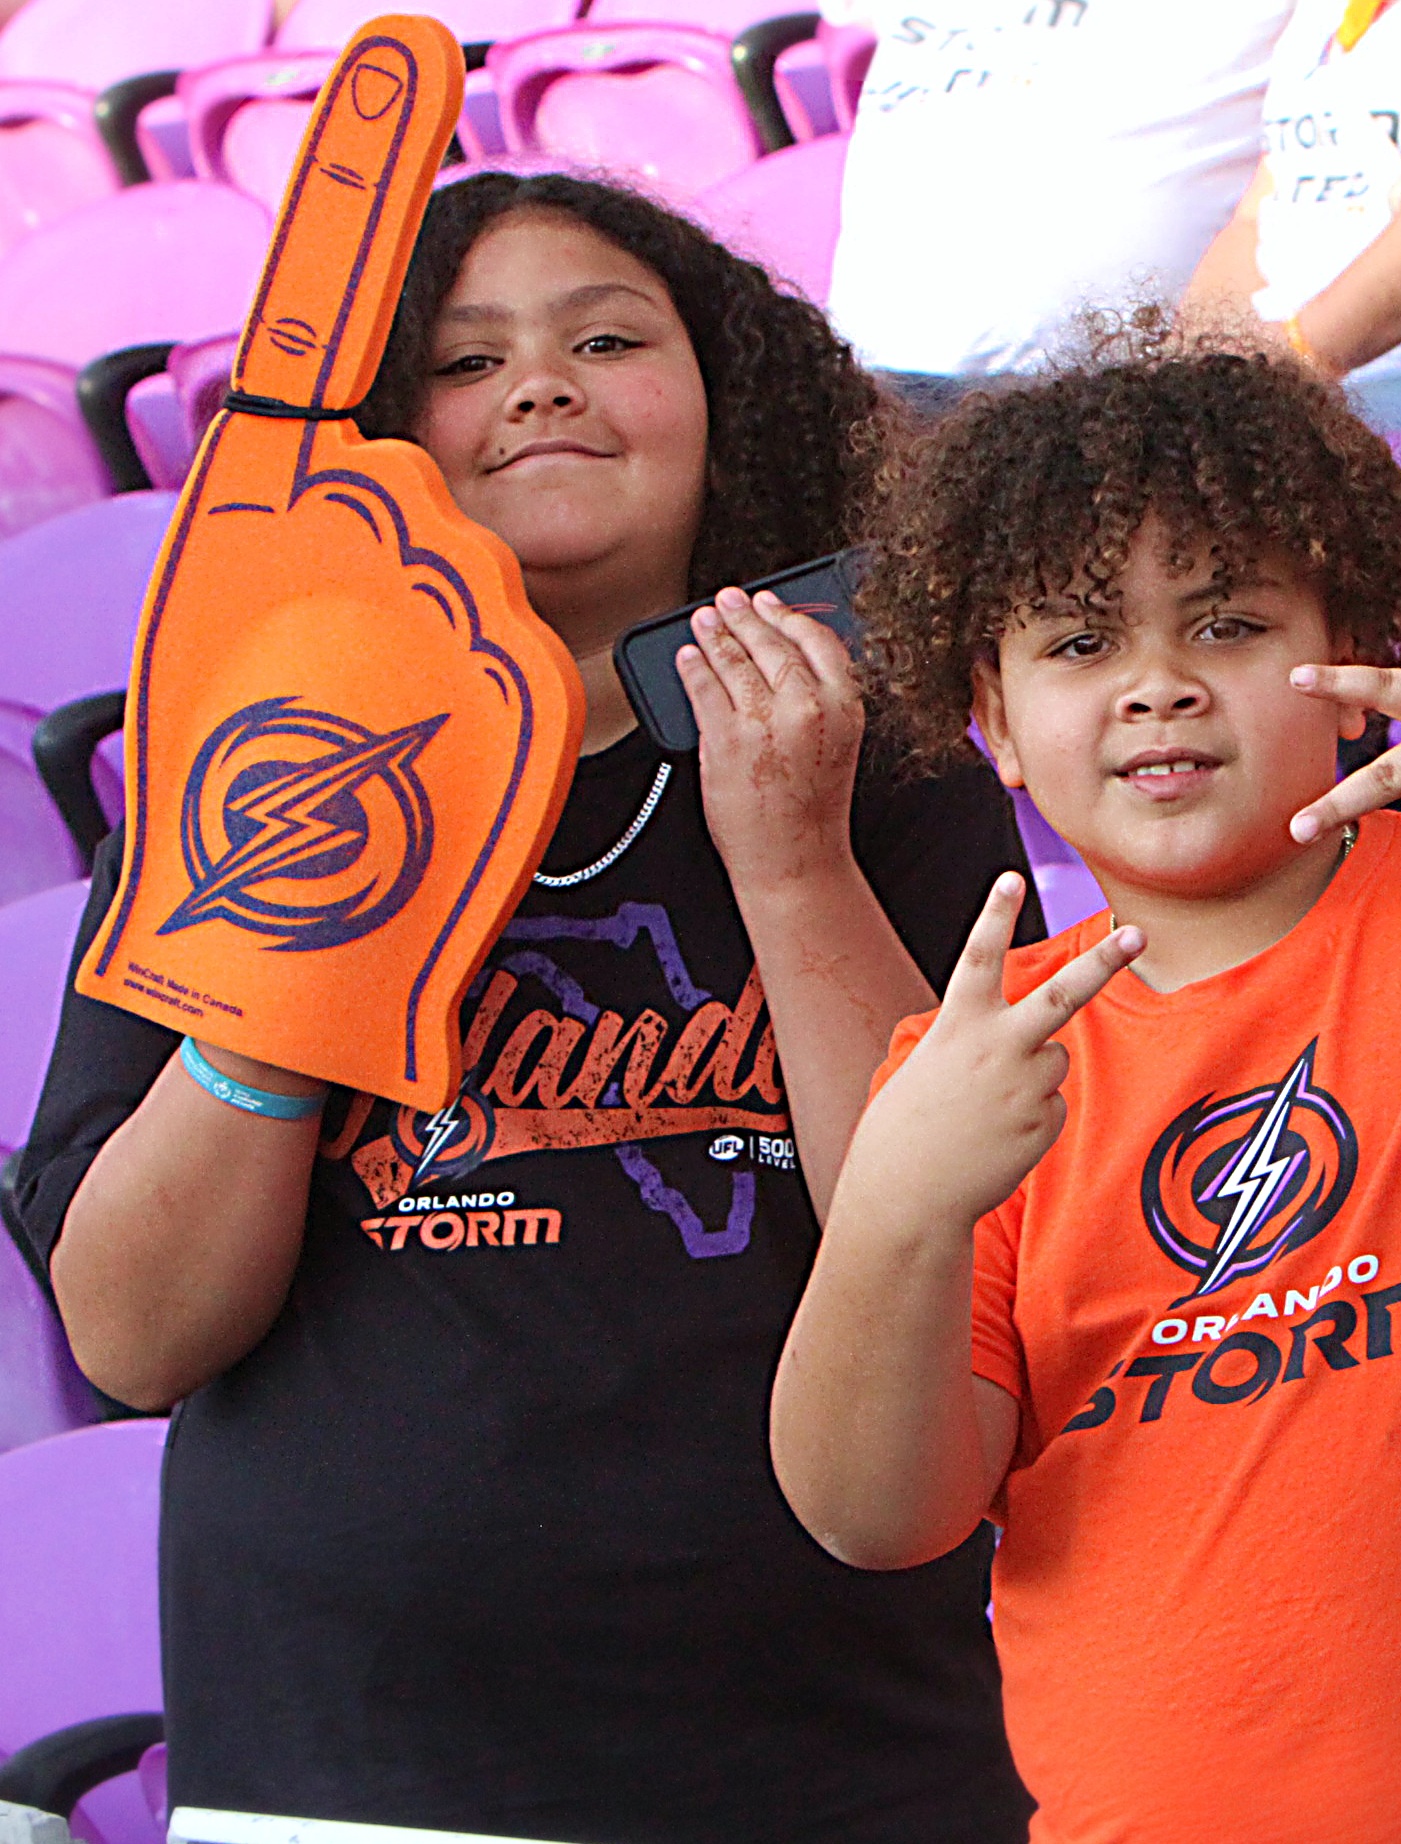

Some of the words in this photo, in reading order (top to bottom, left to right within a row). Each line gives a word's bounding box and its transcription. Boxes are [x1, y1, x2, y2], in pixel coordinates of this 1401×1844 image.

[124, 979, 203, 1017] www.wincraft.com
[128, 962, 164, 985] WinCraft
[167, 979, 188, 995] Made
[191, 988, 200, 1001] in
[203, 994, 243, 1016] Canada
[758, 1135, 795, 1158] 500
[757, 1154, 797, 1170] LEVEL
[398, 1190, 515, 1213] ORLANDO
[359, 1207, 563, 1251] STORM
